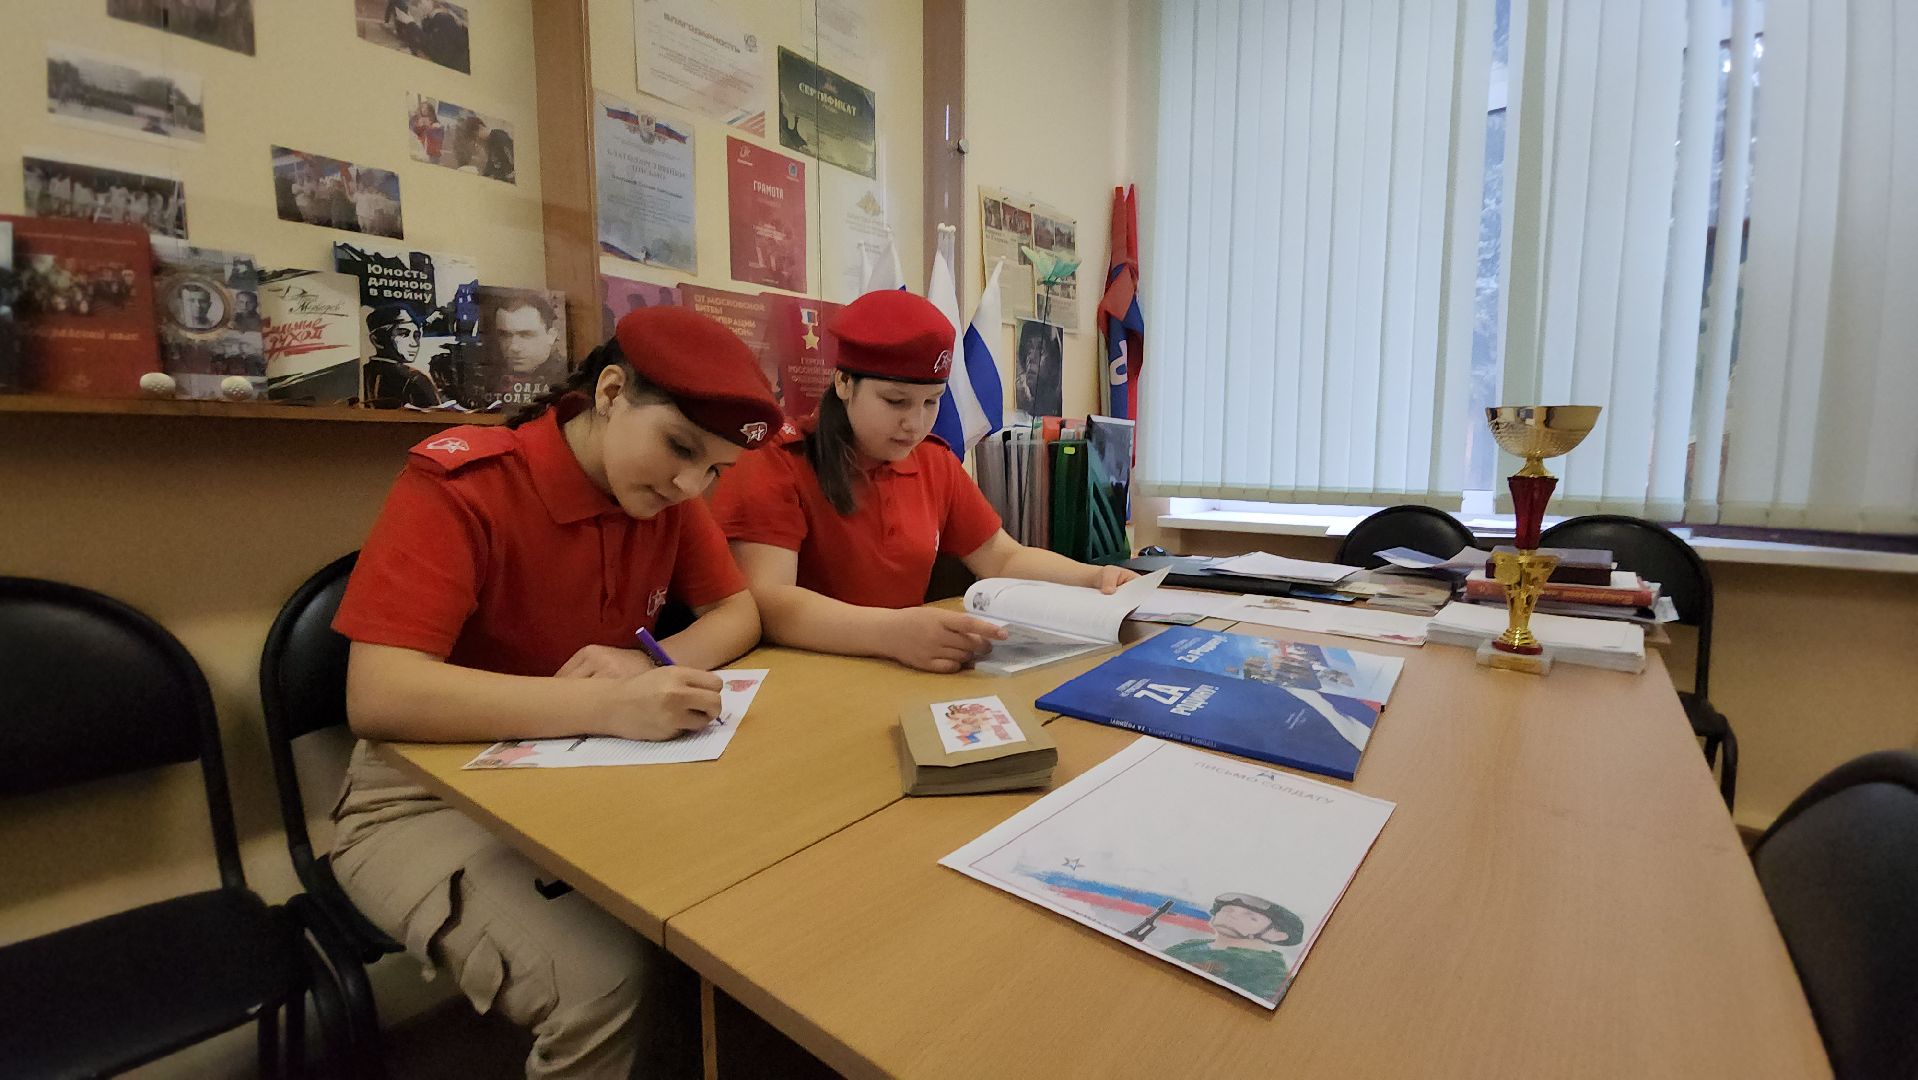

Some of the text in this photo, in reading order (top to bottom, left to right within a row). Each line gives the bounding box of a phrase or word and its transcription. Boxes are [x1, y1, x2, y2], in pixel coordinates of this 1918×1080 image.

[798, 81, 857, 117] СЕРТИФИКАТ
[753, 179, 785, 201] ГРАМОТА
[367, 263, 428, 280] Юность
[367, 276, 433, 291] длиною
[369, 287, 432, 304] в войну
[1133, 683, 1192, 706] ZA
[1194, 760, 1335, 804] ПИСЬМО СОЛДАТУ
